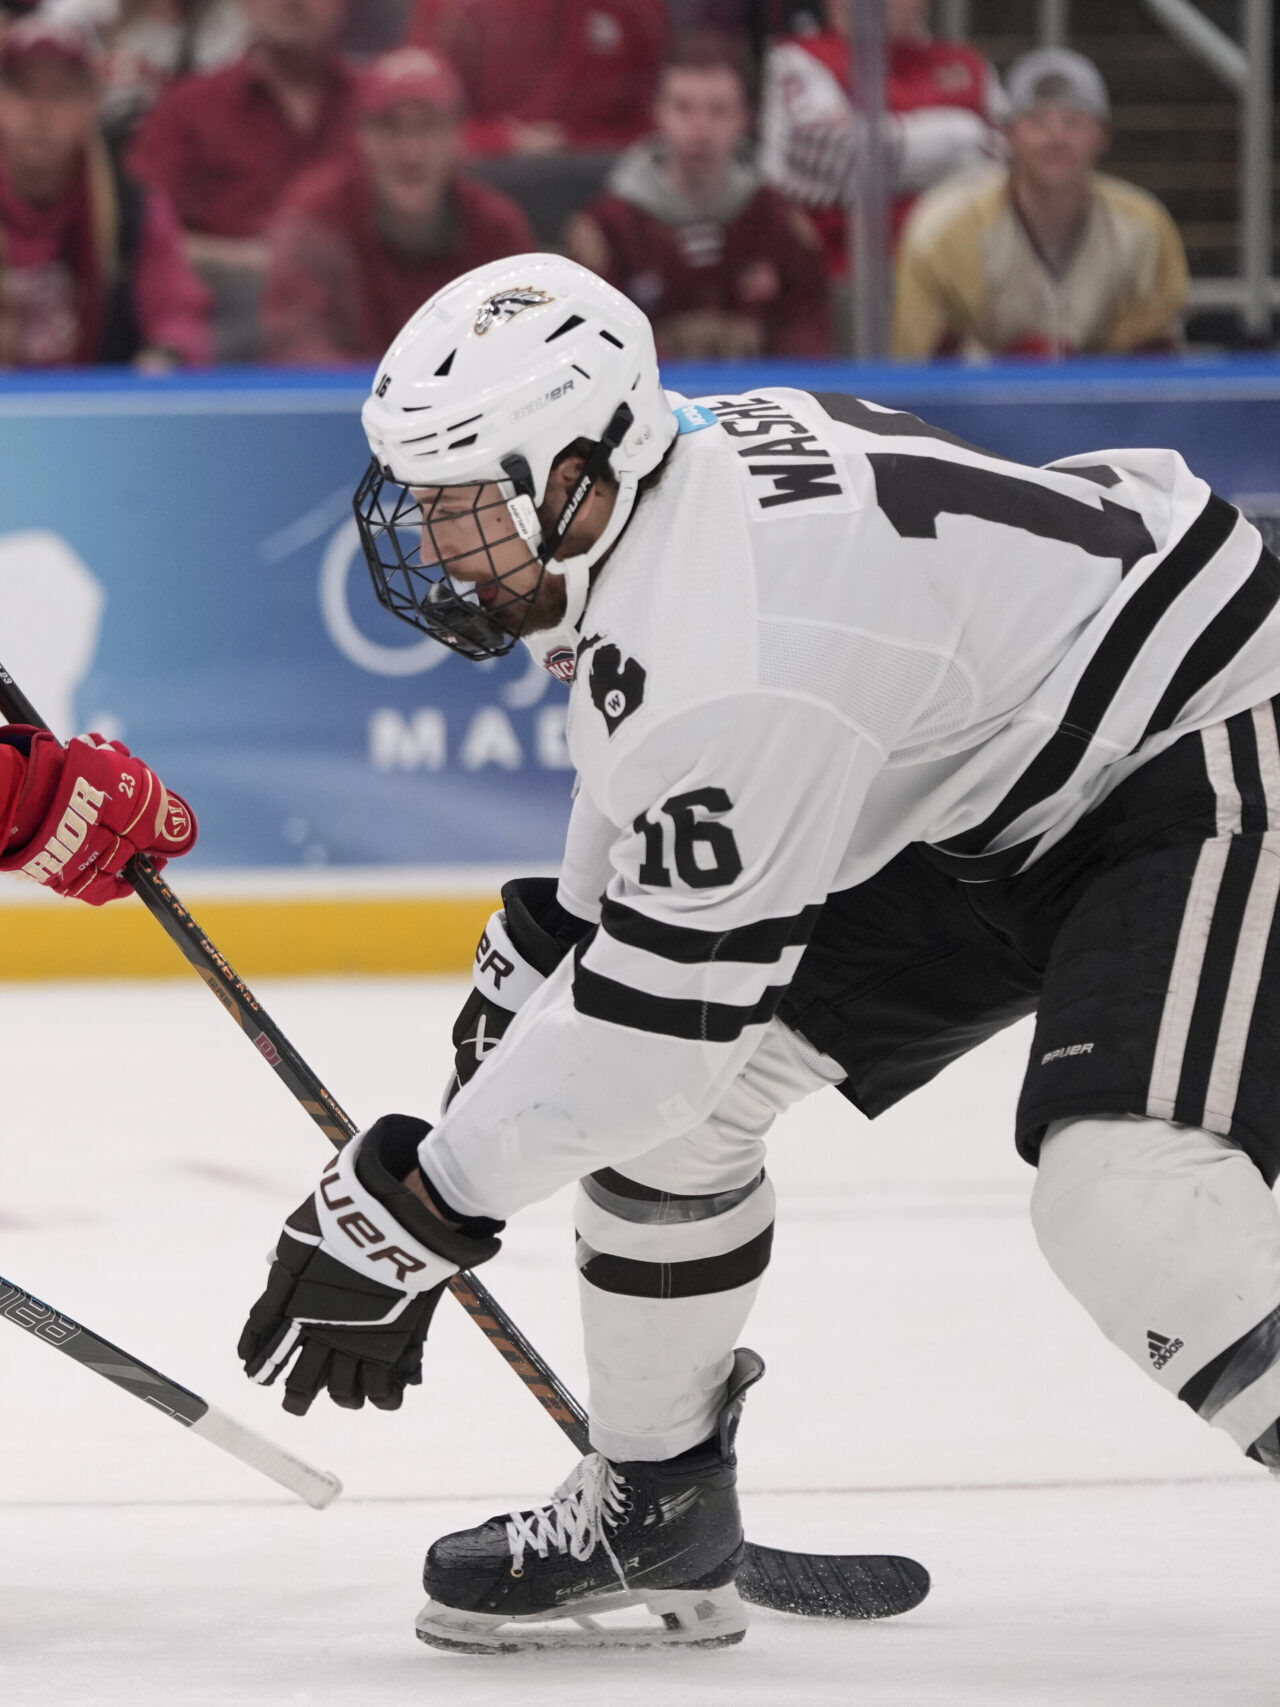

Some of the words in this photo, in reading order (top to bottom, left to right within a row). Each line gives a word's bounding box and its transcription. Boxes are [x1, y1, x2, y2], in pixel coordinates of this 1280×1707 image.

[375, 374, 391, 398] 16
[558, 475, 591, 536] BAUER
[118, 772, 137, 799] 23
[632, 786, 744, 889] 16
[1041, 1042, 1095, 1066] BAUER
[1152, 1338, 1185, 1371] adidas
